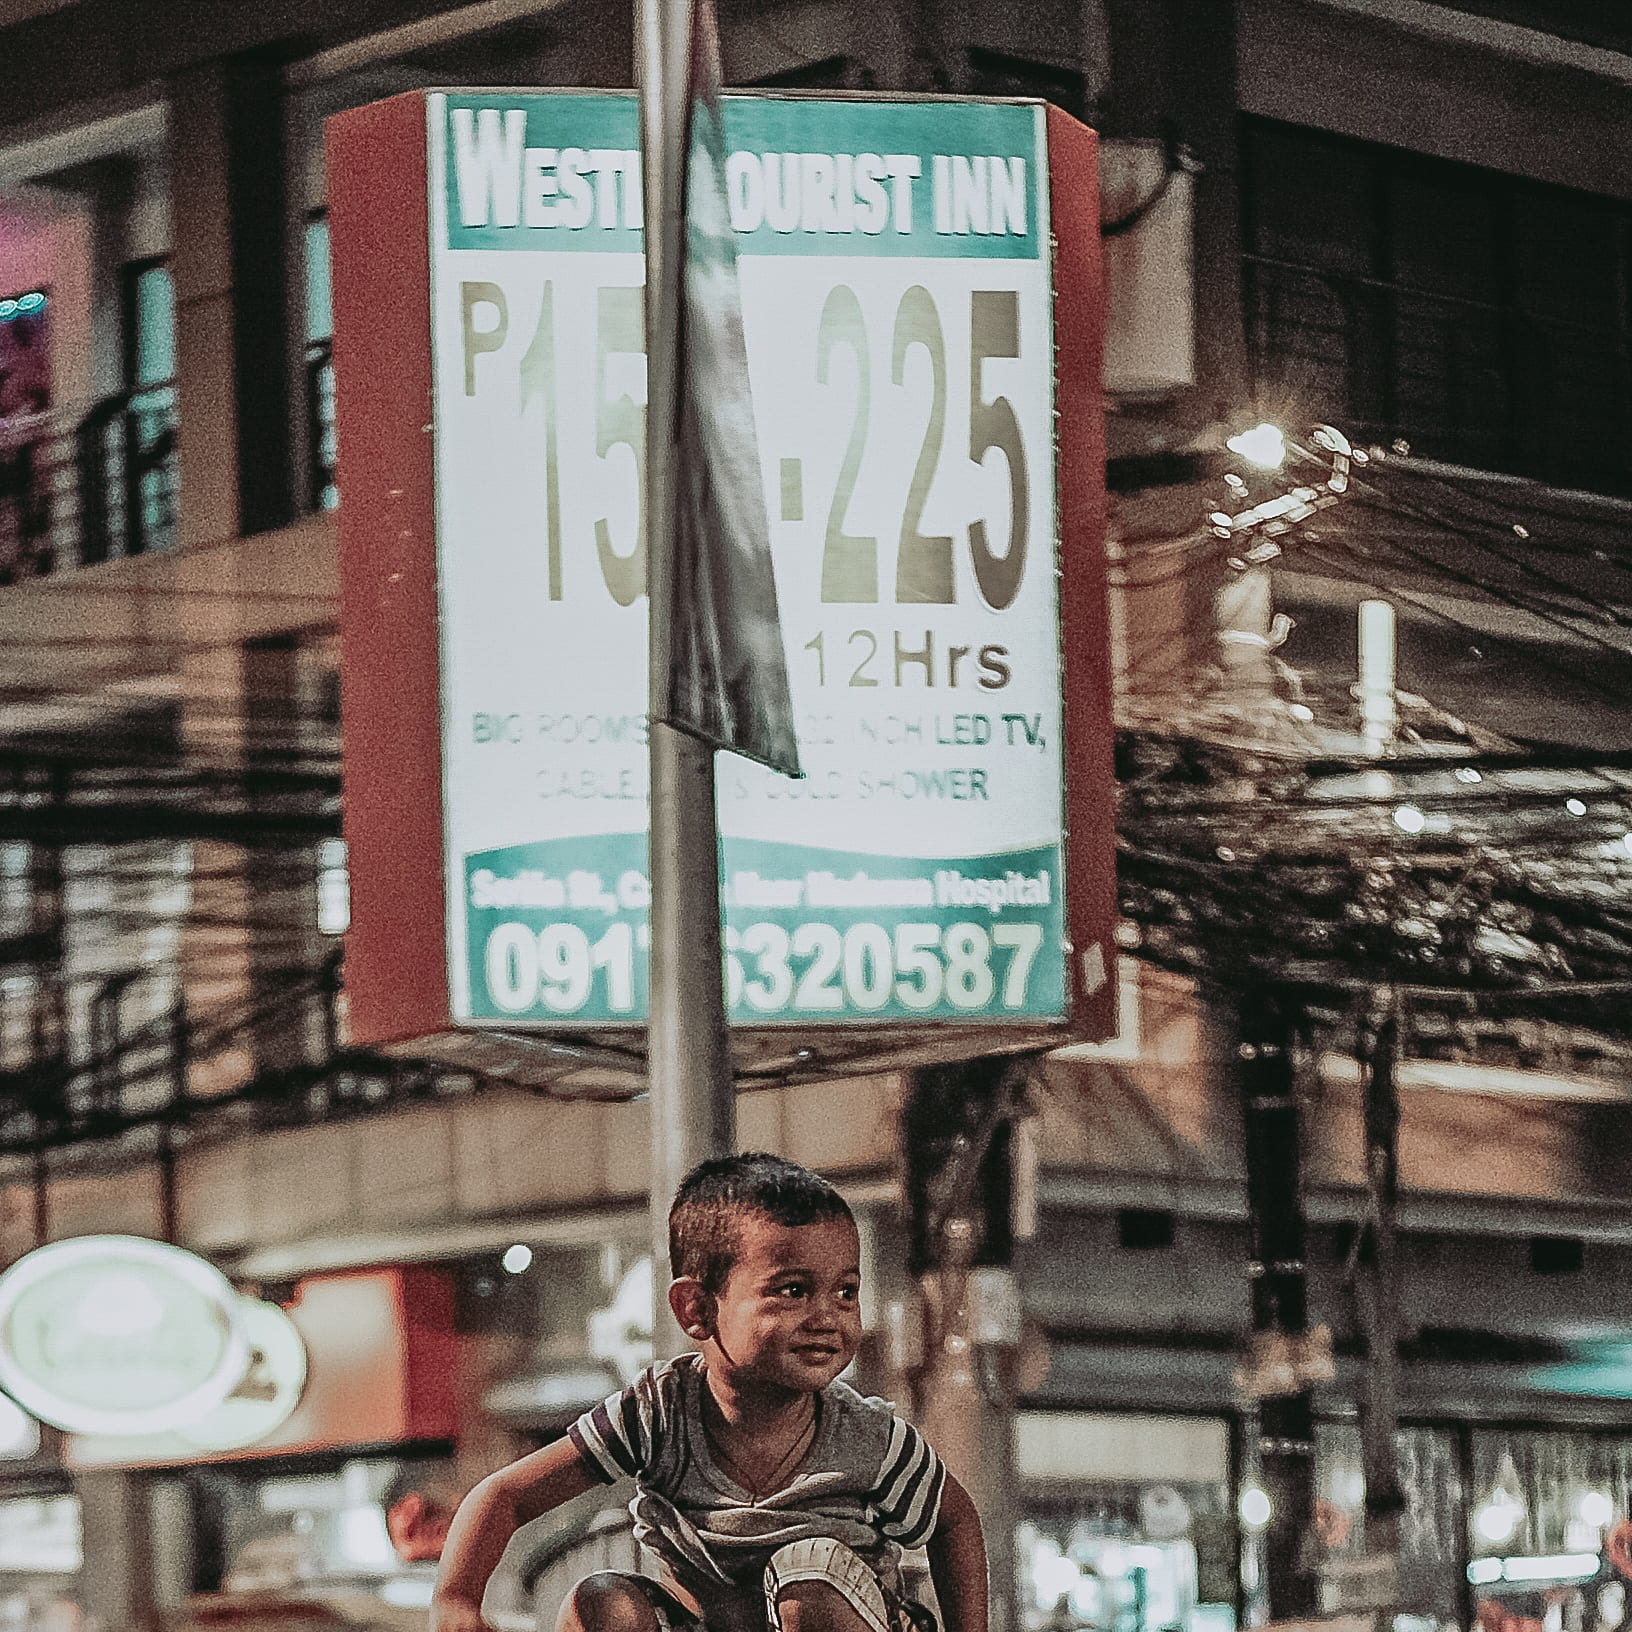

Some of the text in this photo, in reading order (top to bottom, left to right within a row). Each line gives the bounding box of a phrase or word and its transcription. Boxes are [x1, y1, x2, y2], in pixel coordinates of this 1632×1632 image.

[725, 150, 921, 235] OURIST
[932, 154, 1028, 237] INN
[460, 279, 1030, 612] P15-225
[804, 630, 1013, 690] 12Hrs
[471, 710, 521, 744] BIG
[536, 713, 648, 745] ROOMS
[853, 714, 924, 745] INCH
[935, 713, 993, 746] LED
[1000, 712, 1047, 753] TV,
[857, 767, 990, 800] SHOWER
[934, 870, 1051, 915] Hospital
[486, 921, 1044, 1013] 091320587
